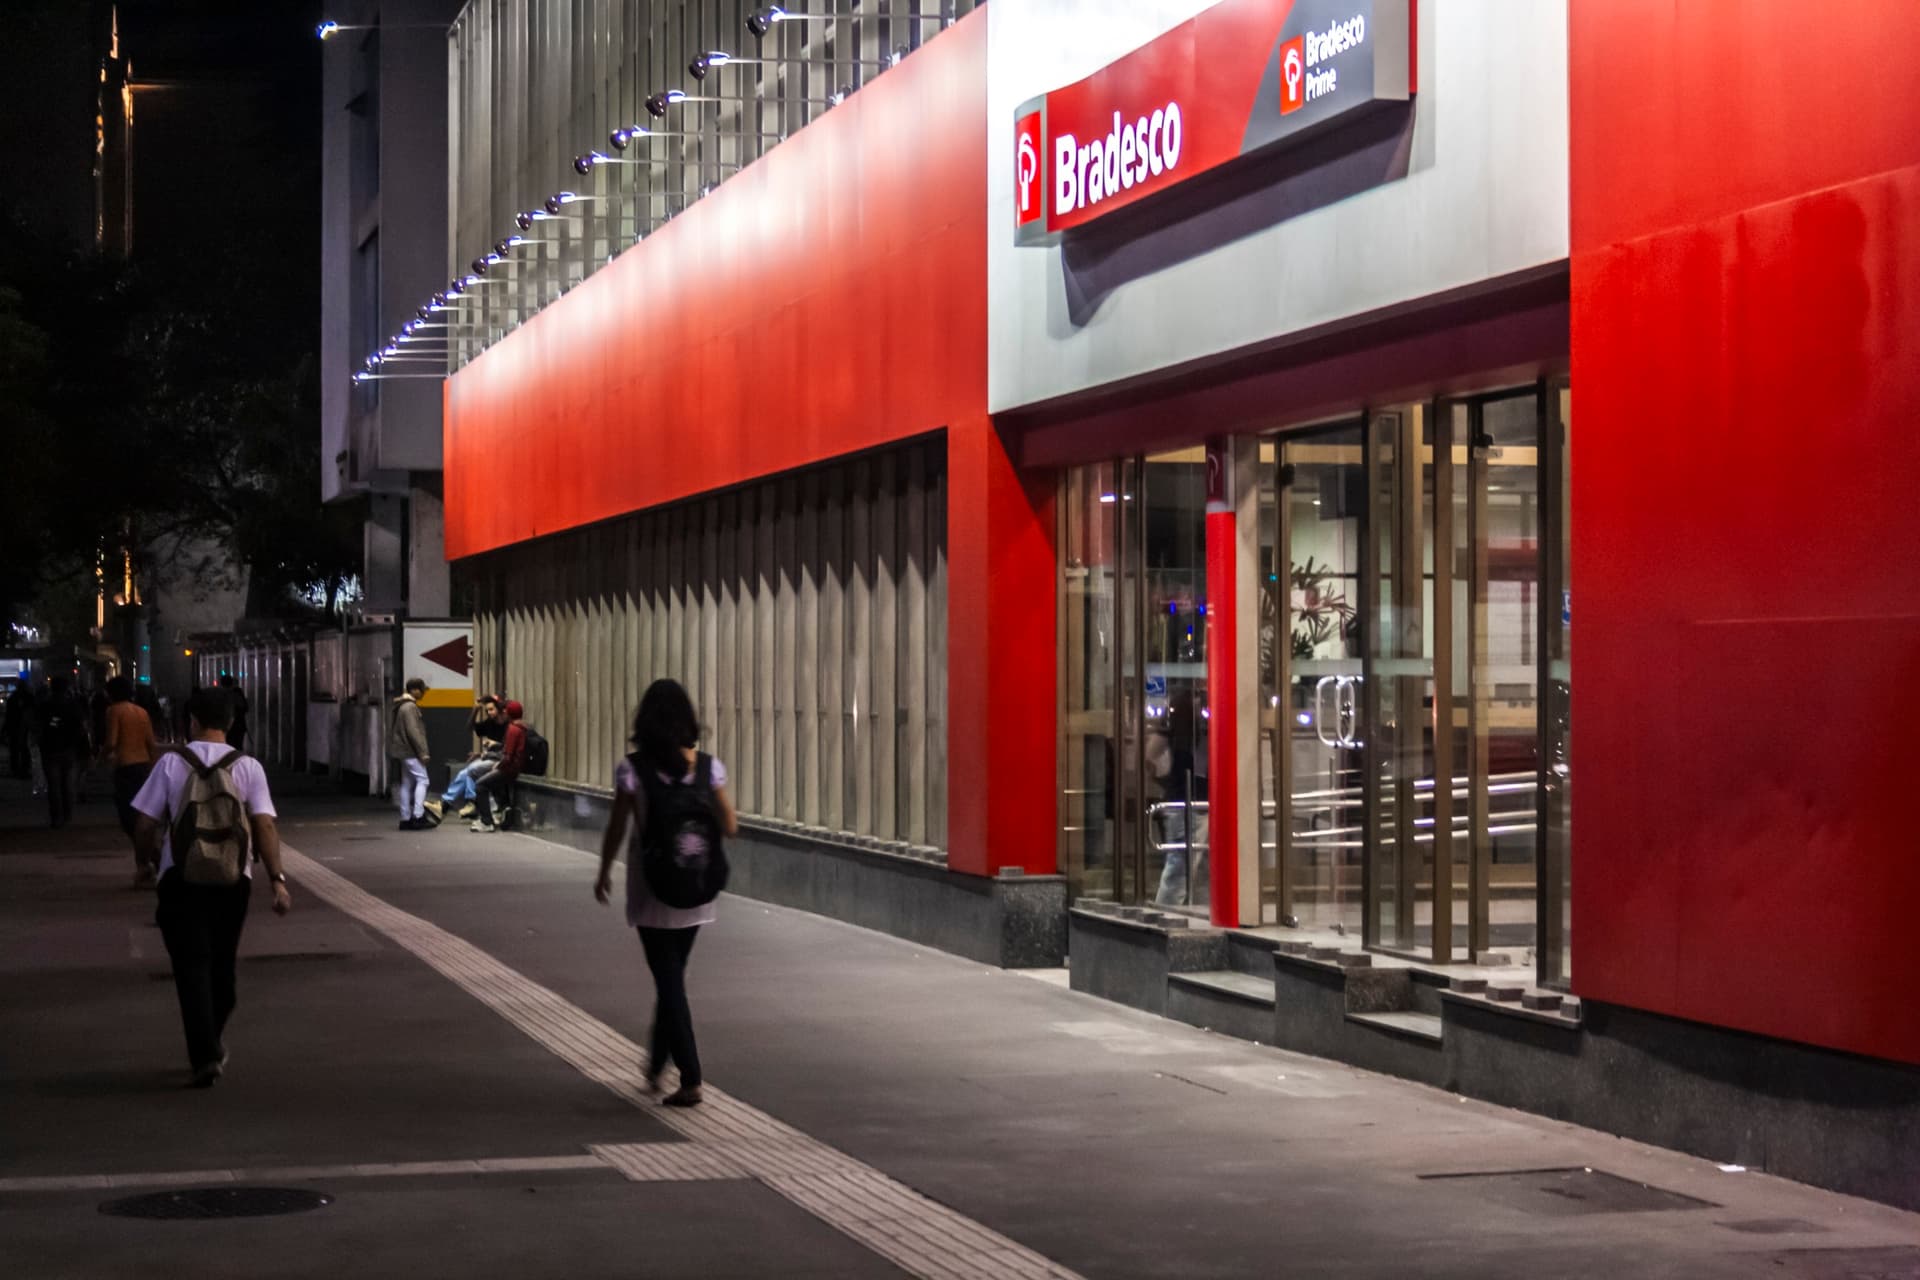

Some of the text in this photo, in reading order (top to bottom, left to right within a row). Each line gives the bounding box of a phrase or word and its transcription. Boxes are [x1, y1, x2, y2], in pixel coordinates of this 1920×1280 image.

[1306, 14, 1366, 67] Bradesco
[1306, 67, 1337, 102] Prime
[1055, 102, 1181, 215] Bradesco
